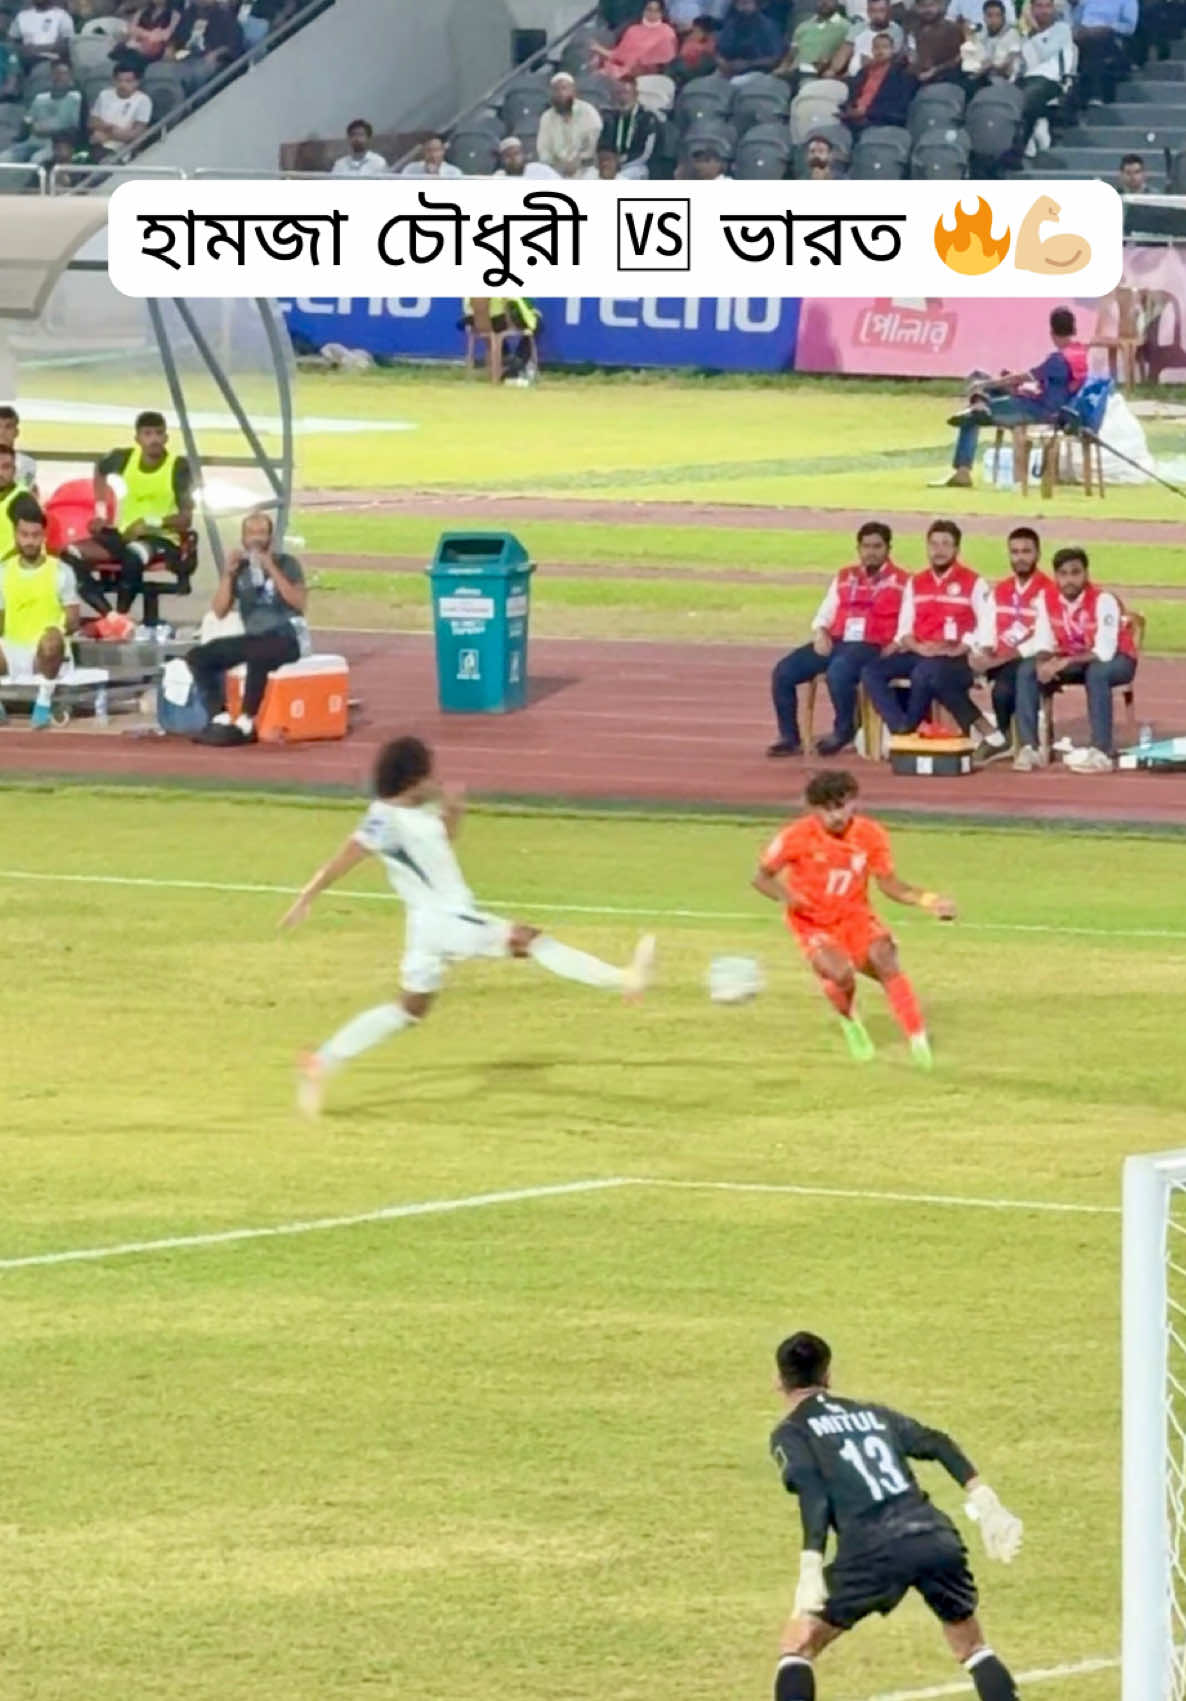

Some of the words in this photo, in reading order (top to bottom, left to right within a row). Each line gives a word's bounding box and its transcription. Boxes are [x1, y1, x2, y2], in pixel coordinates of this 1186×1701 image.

[826, 868, 854, 897] 17
[807, 1410, 887, 1438] MITUL
[838, 1435, 911, 1501] 13
